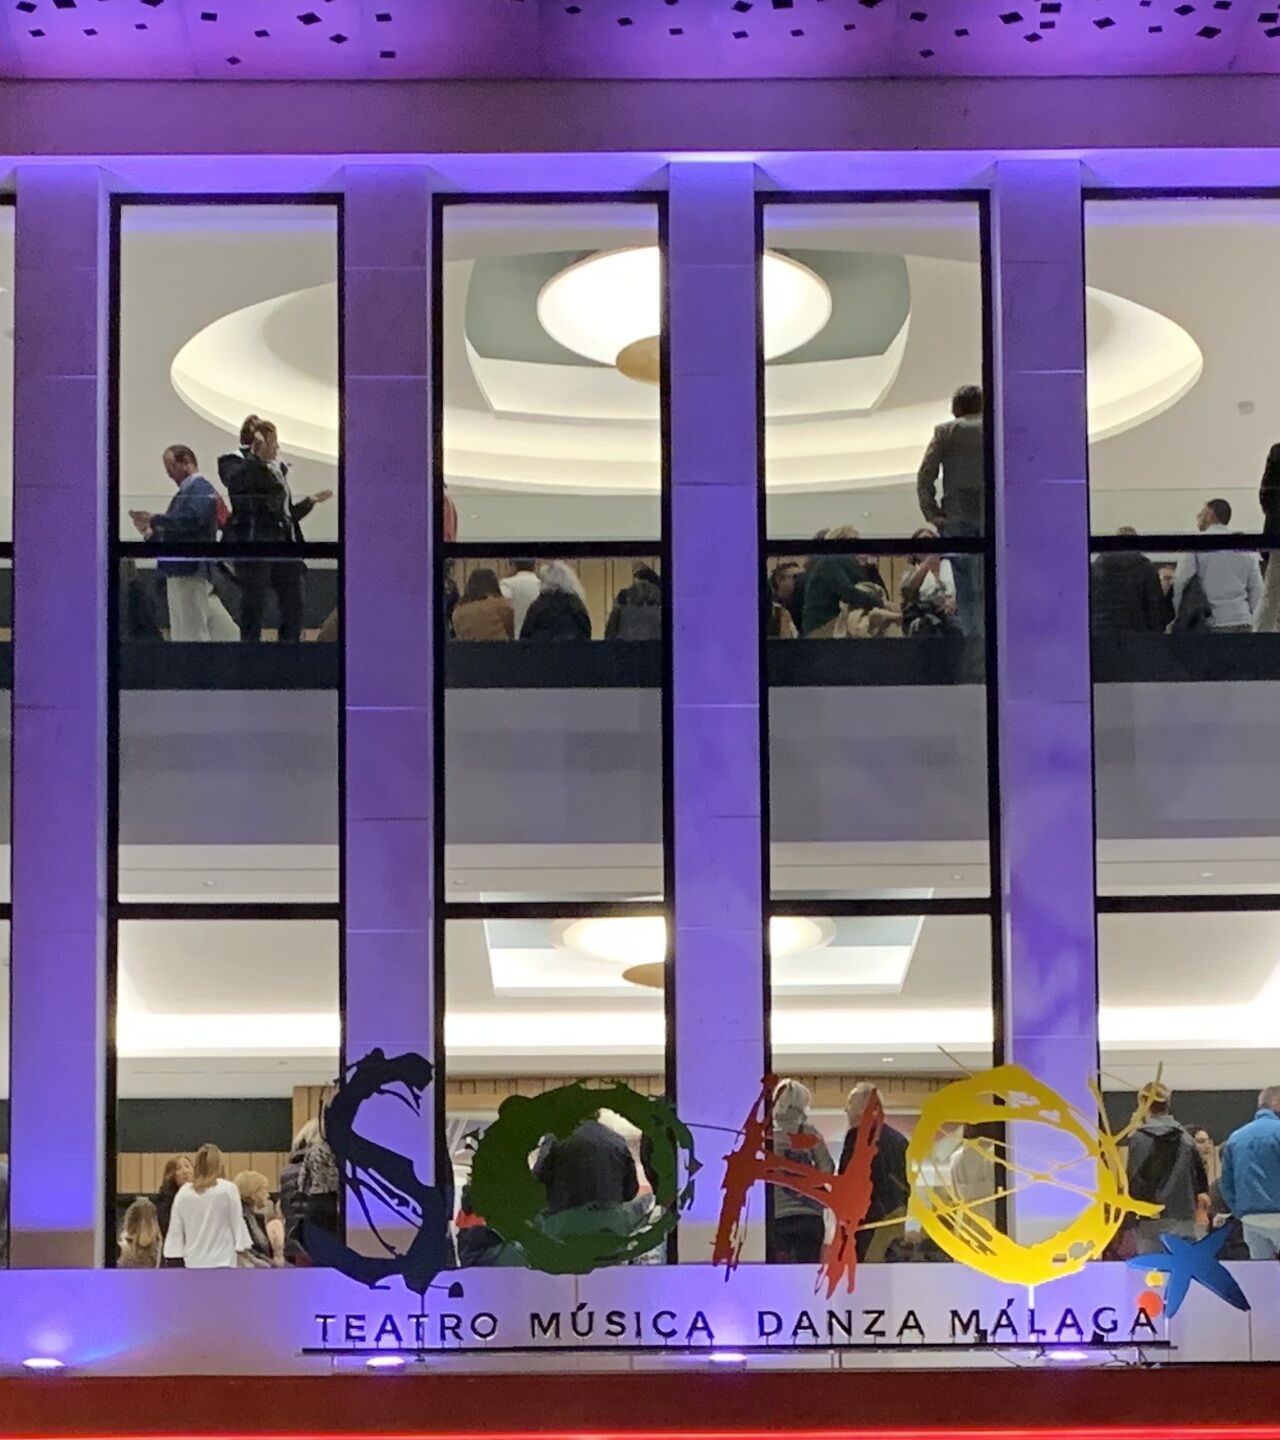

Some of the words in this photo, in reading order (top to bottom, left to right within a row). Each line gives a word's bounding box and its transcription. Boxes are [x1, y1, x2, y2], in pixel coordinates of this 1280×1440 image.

[299, 1048, 1160, 1299] SOHO
[316, 1314, 499, 1342] TEATRO
[529, 1303, 715, 1340] MÚSICA
[757, 1308, 926, 1338] DANZA
[949, 1299, 1158, 1337] MÁLAGA
